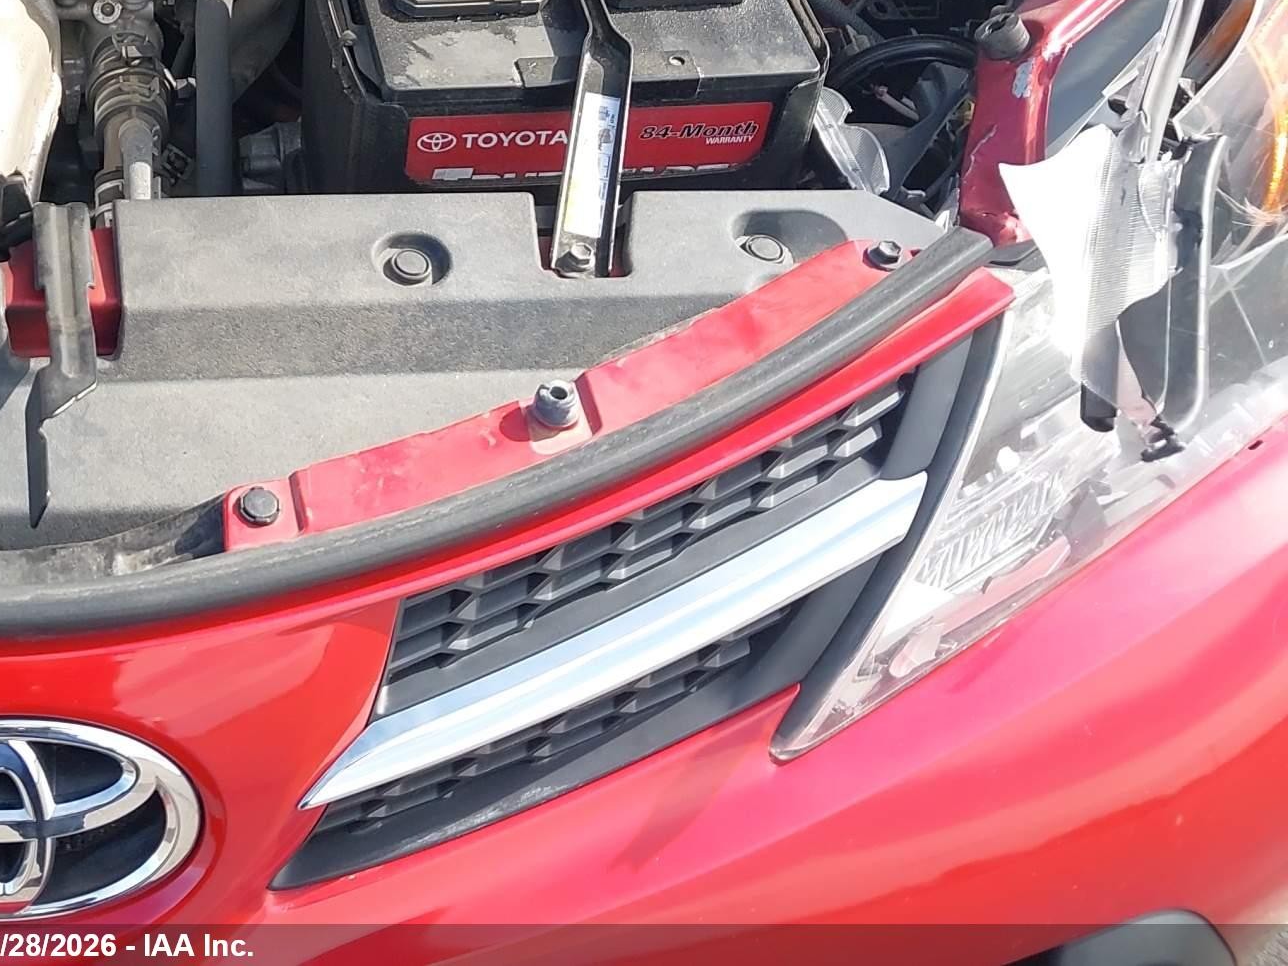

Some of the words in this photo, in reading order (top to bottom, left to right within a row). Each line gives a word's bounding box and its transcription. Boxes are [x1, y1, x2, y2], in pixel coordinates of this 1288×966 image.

[462, 130, 569, 149] TOYOTA
[640, 121, 760, 141] 84-Month
[705, 135, 754, 145] WARRANTY
